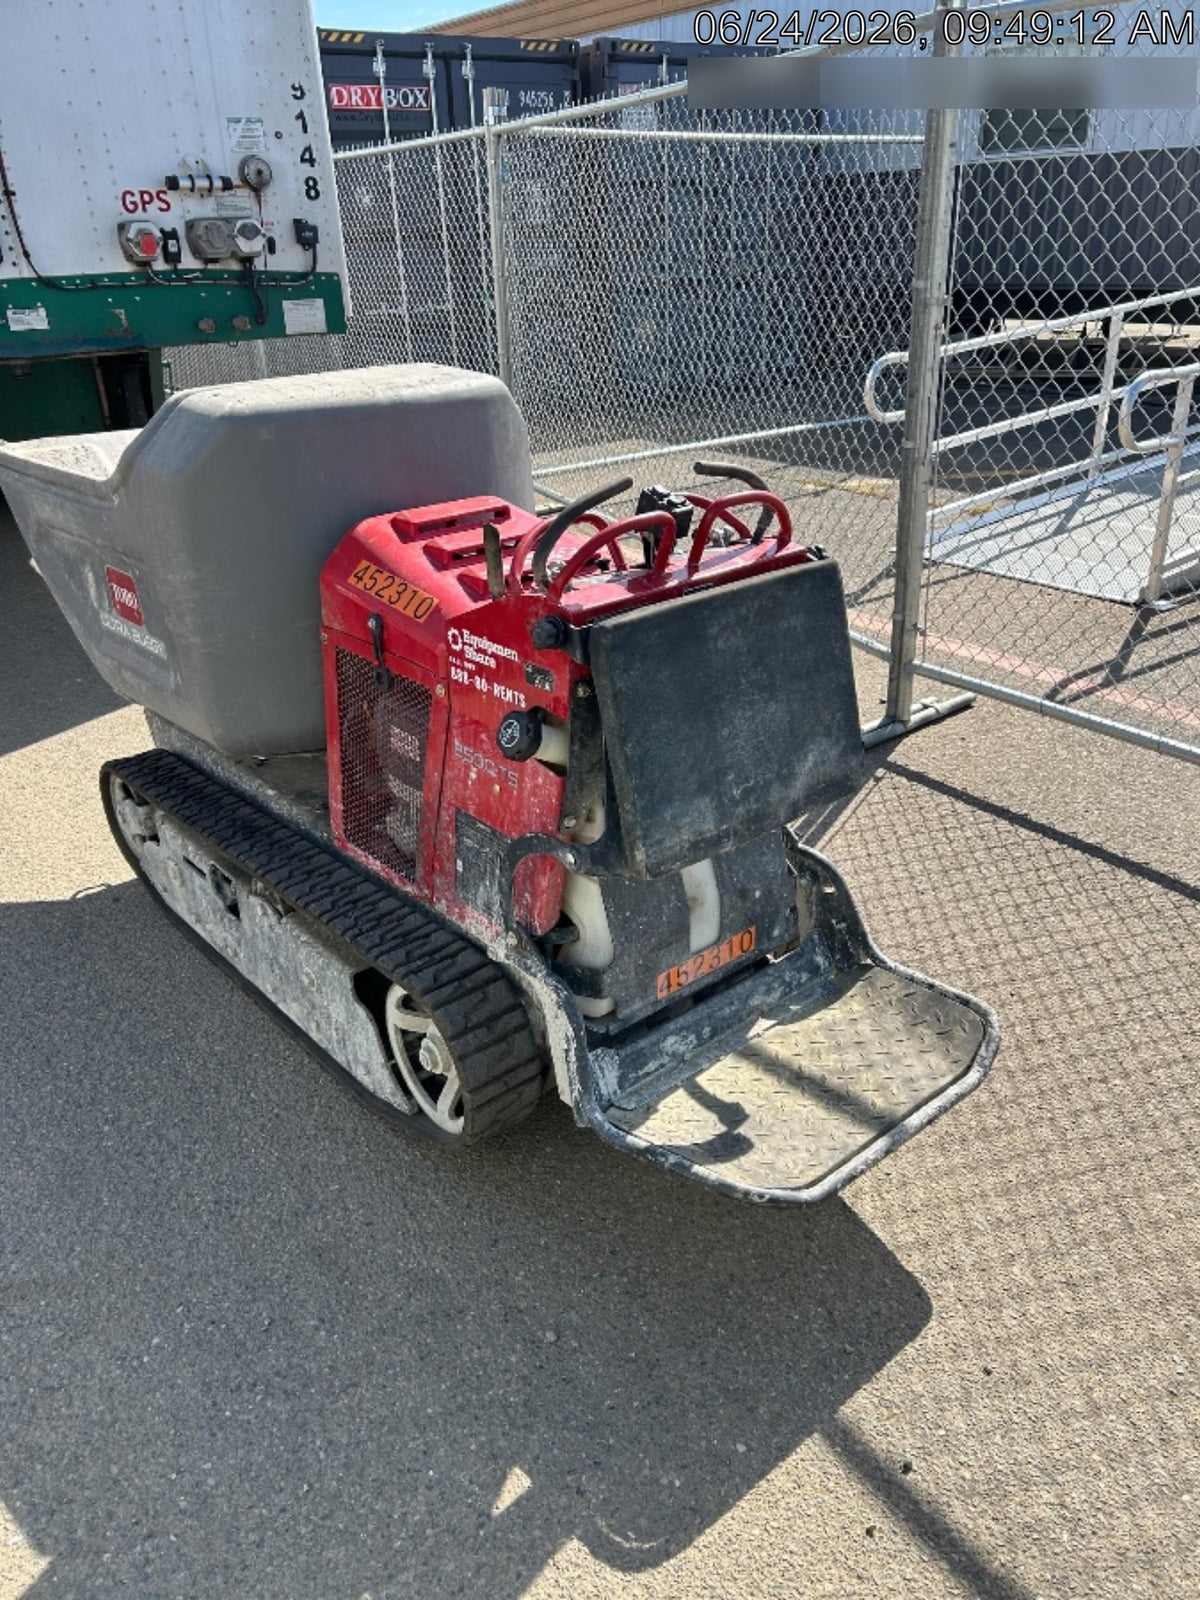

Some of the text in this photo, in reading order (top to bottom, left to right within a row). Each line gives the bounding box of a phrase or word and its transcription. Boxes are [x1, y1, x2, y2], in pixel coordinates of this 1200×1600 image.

[121, 189, 171, 214] GPS
[353, 564, 434, 620] 452310
[462, 628, 521, 663] Equipmen
[463, 645, 497, 670] Share
[658, 928, 753, 993] 452310
